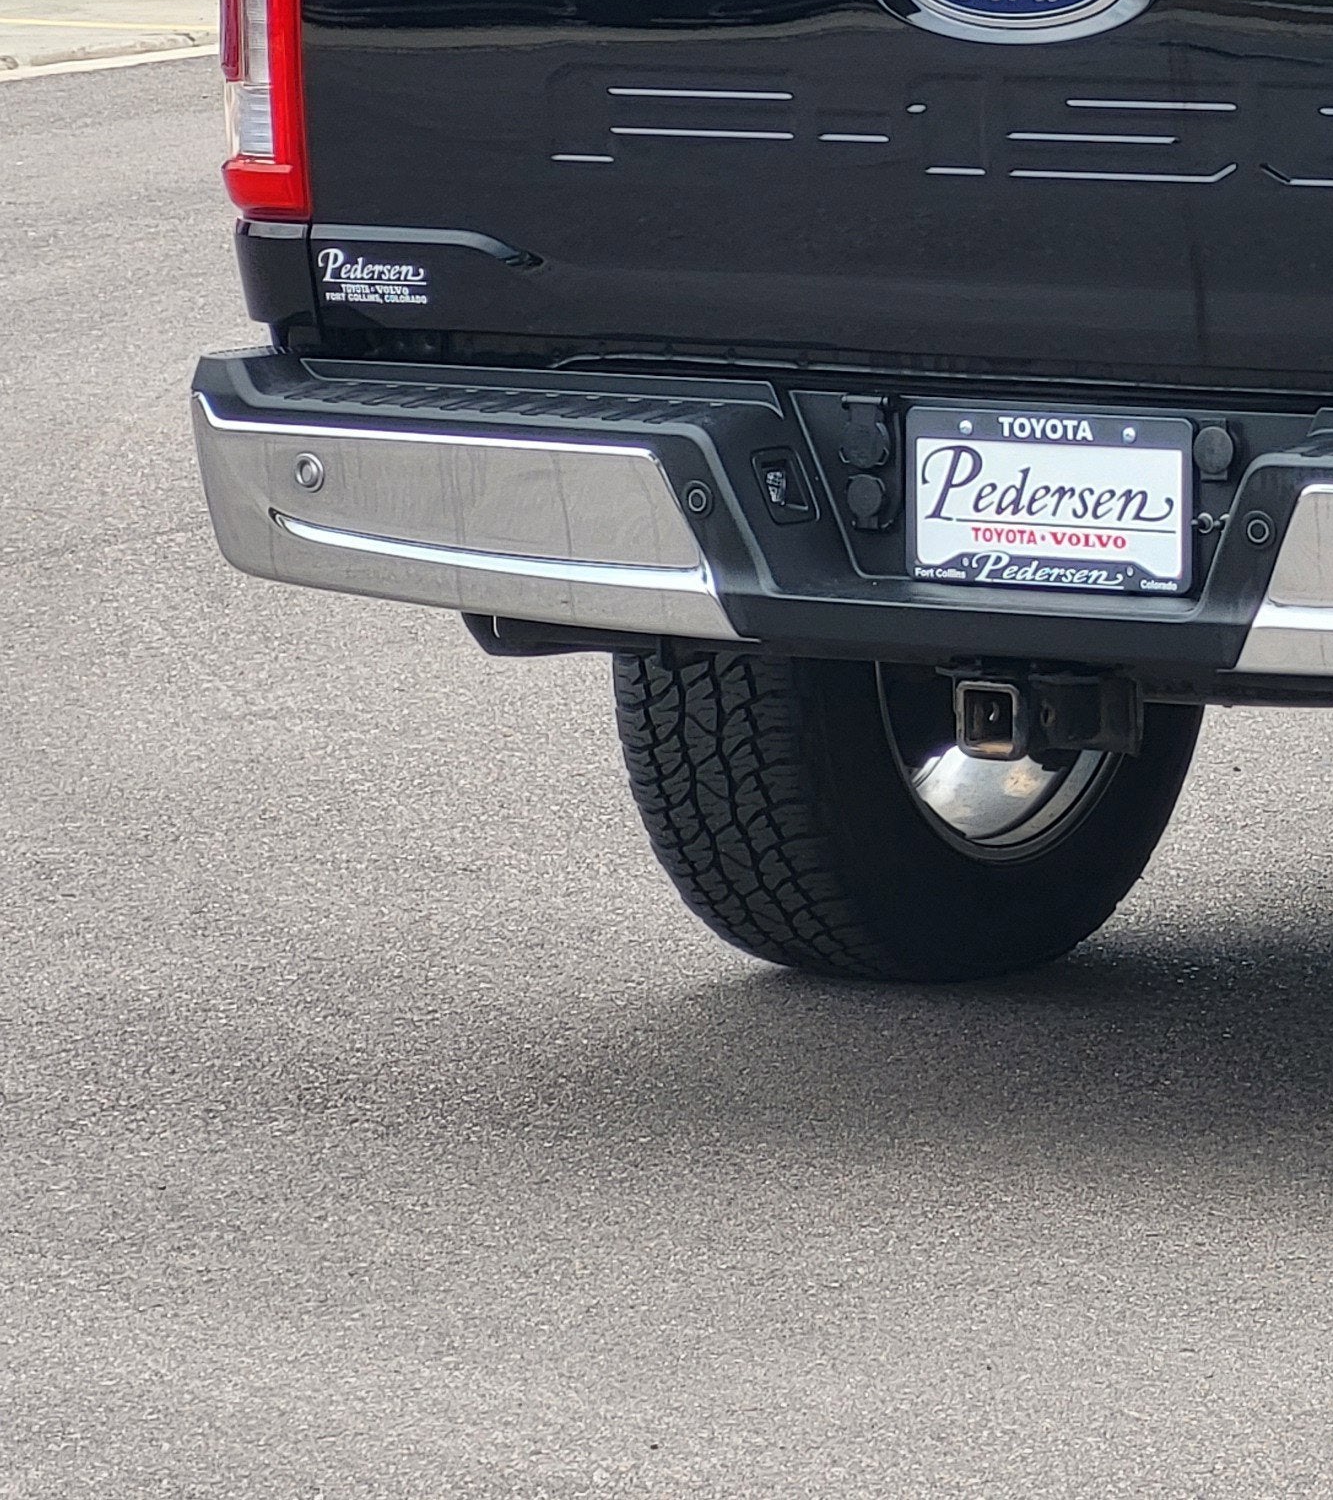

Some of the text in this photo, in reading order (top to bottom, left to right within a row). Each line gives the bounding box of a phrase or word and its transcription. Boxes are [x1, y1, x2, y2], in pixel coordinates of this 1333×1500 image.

[318, 248, 425, 281] Pedersen
[998, 417, 1093, 441] TOYOTA
[921, 445, 1174, 522] Pedersen
[972, 527, 1127, 549] TOYOTA VOLVO
[914, 567, 966, 579] Fort Collins
[972, 551, 1124, 585] Pedersen
[1140, 579, 1178, 591] Colorado
